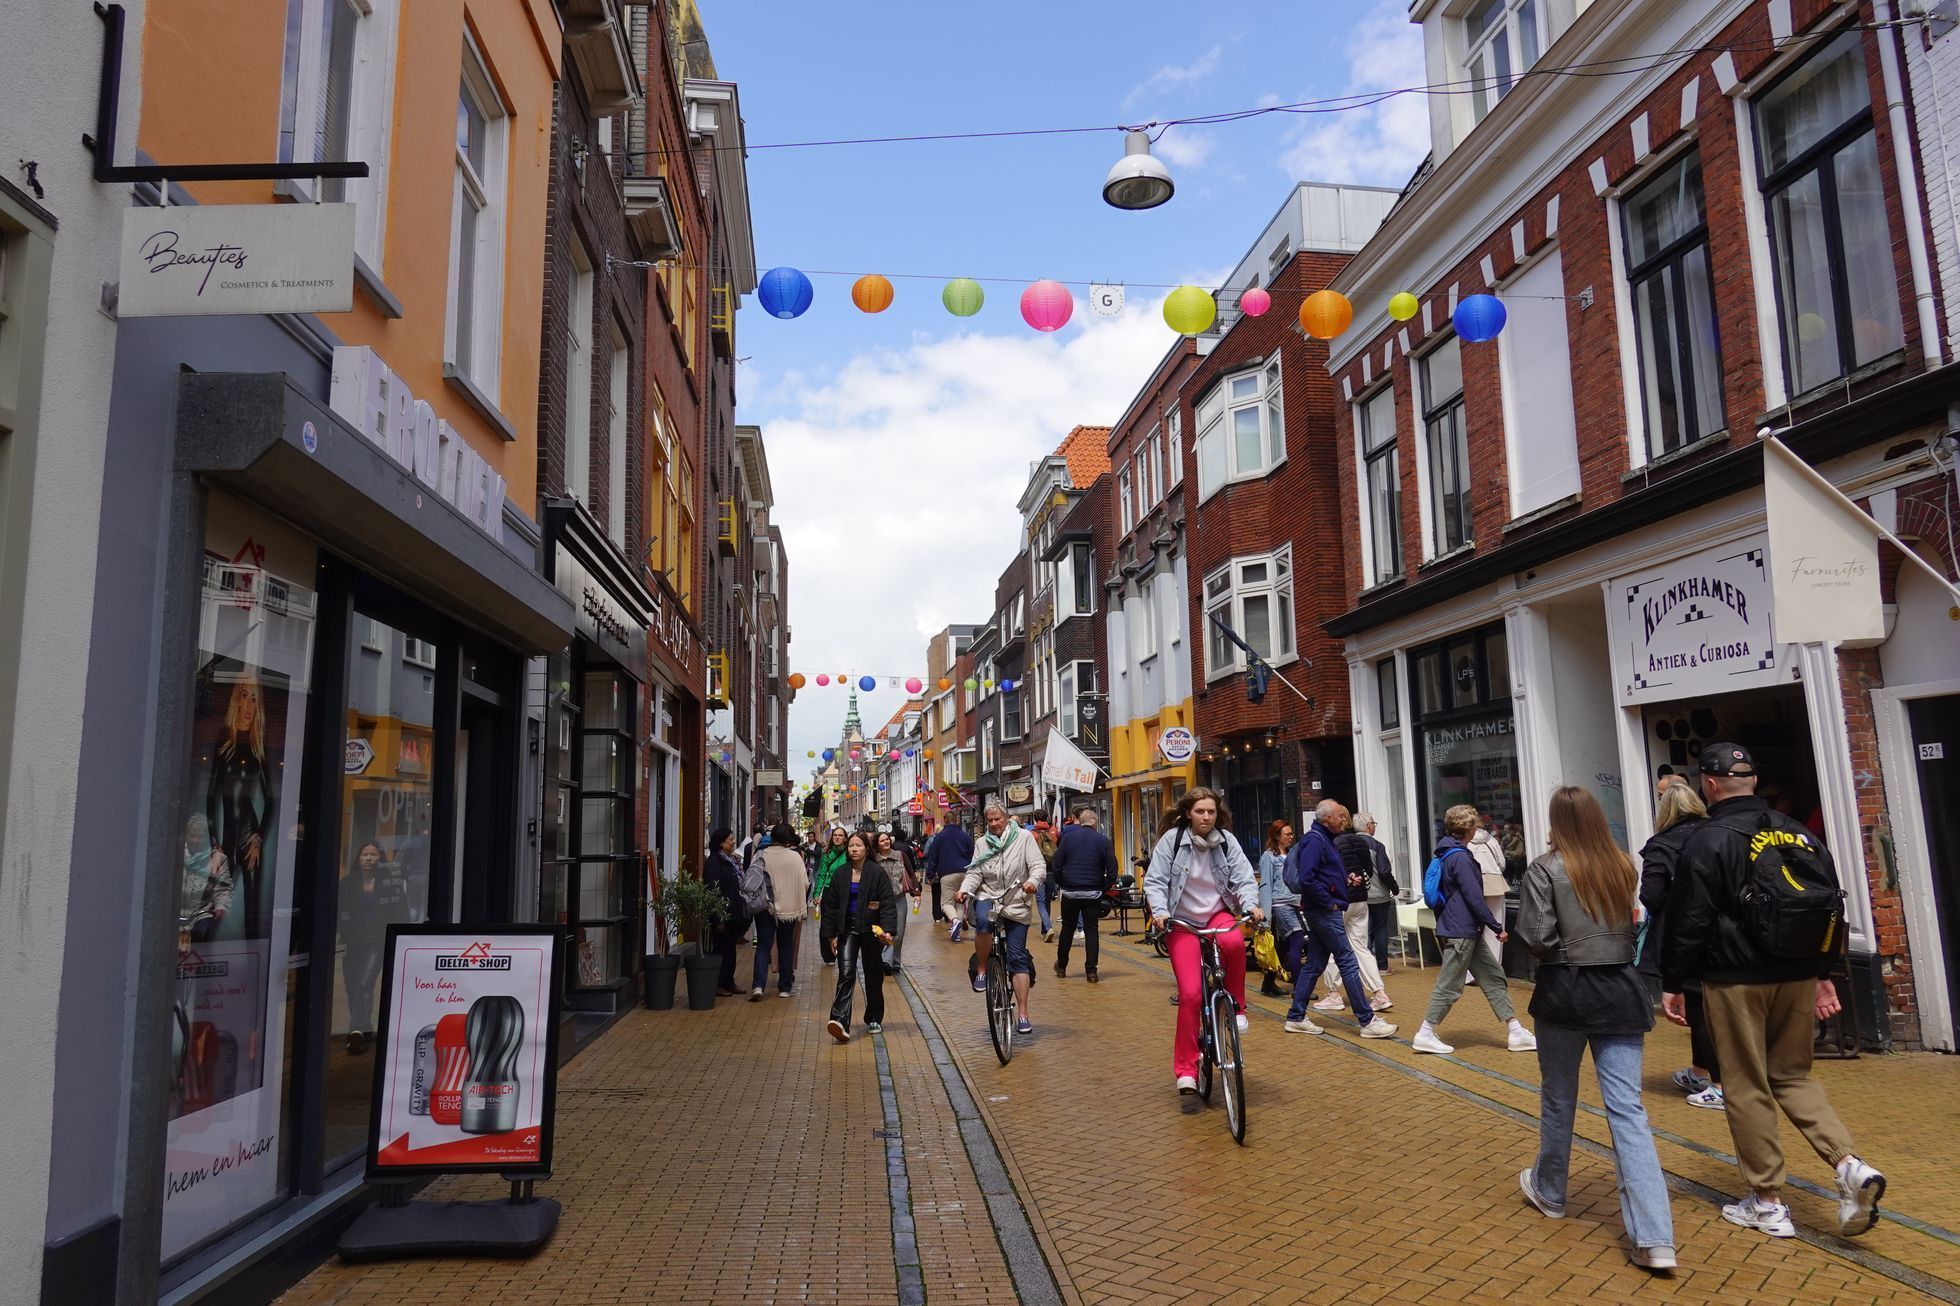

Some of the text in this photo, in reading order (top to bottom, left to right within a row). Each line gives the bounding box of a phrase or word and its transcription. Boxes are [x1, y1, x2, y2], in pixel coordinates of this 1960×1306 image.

[139, 231, 248, 296] Beauties
[271, 280, 279, 288] &
[1102, 294, 1113, 307] G
[362, 346, 507, 546] EROTIEK
[1792, 556, 1869, 584] Favourites
[1643, 576, 1750, 648] KLINKHAMER
[1690, 655, 1698, 667] &
[1084, 723, 1099, 746] N
[1922, 745, 1935, 758] 52
[1074, 767, 1095, 785] Tall
[440, 958, 508, 968] DELTA SHOP
[415, 976, 457, 989] Voor haar
[449, 991, 465, 1003] hem
[412, 1035, 427, 1112] FLIP GRAVITY
[167, 1135, 275, 1201] hem en haar
